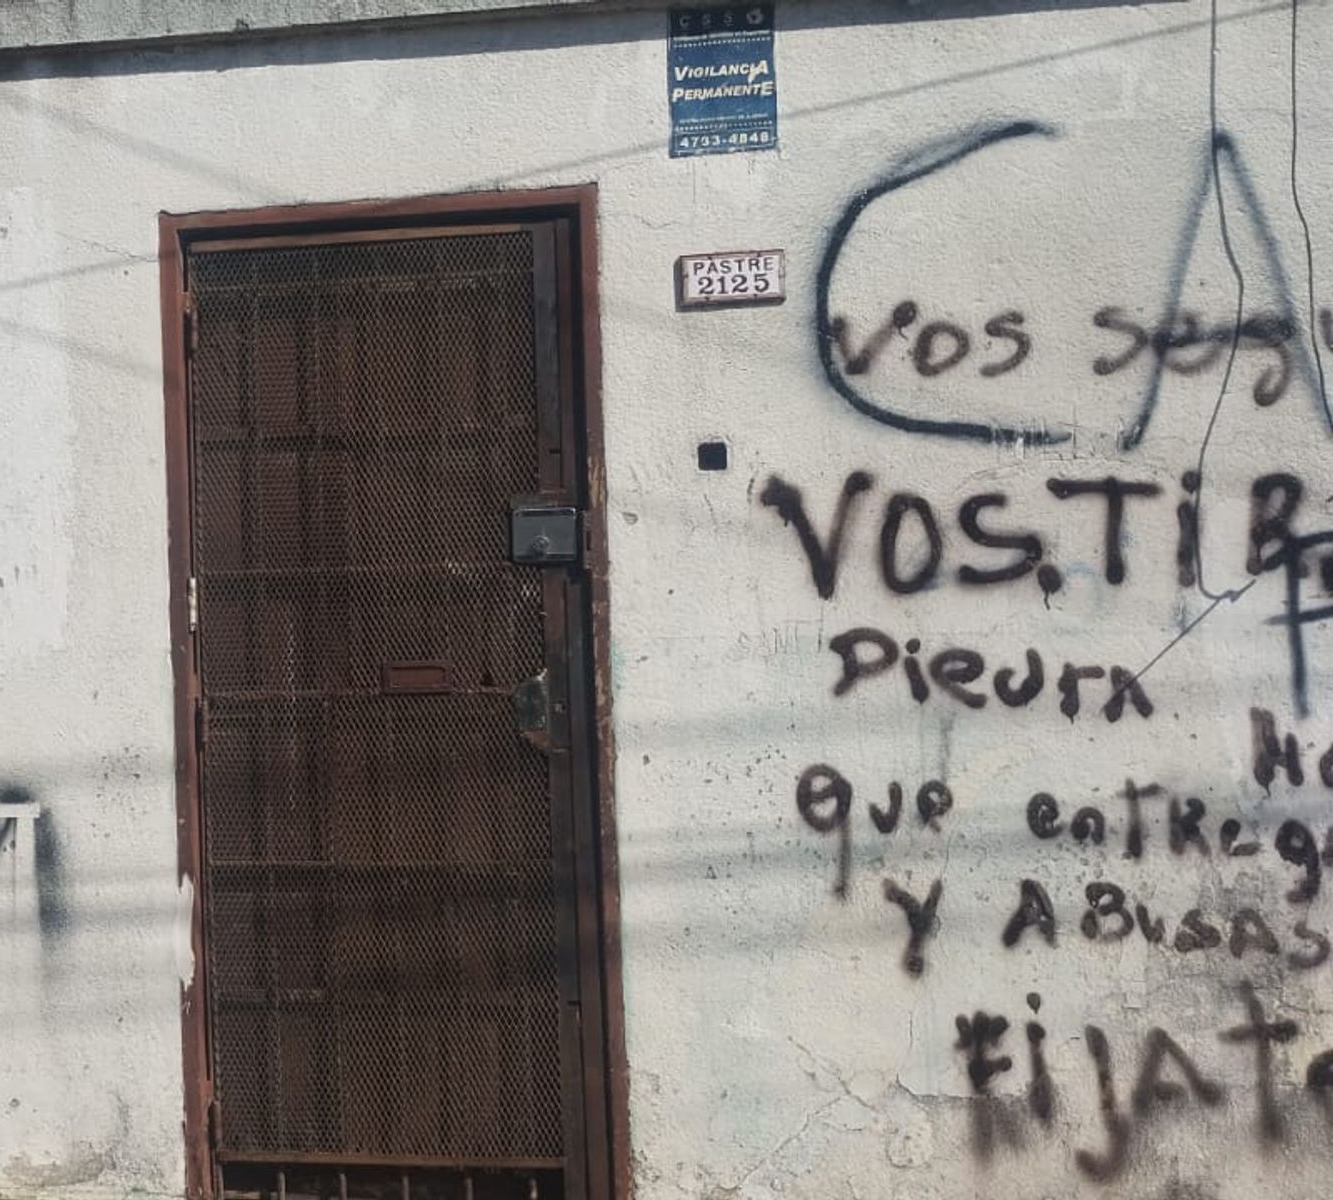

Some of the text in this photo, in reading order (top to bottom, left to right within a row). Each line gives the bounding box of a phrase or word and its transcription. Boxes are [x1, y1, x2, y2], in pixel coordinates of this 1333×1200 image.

[674, 60, 769, 81] VIGILANCIA
[672, 81, 775, 102] PERMANENTE
[693, 257, 775, 275] PASTRE
[698, 273, 770, 294] 2125
